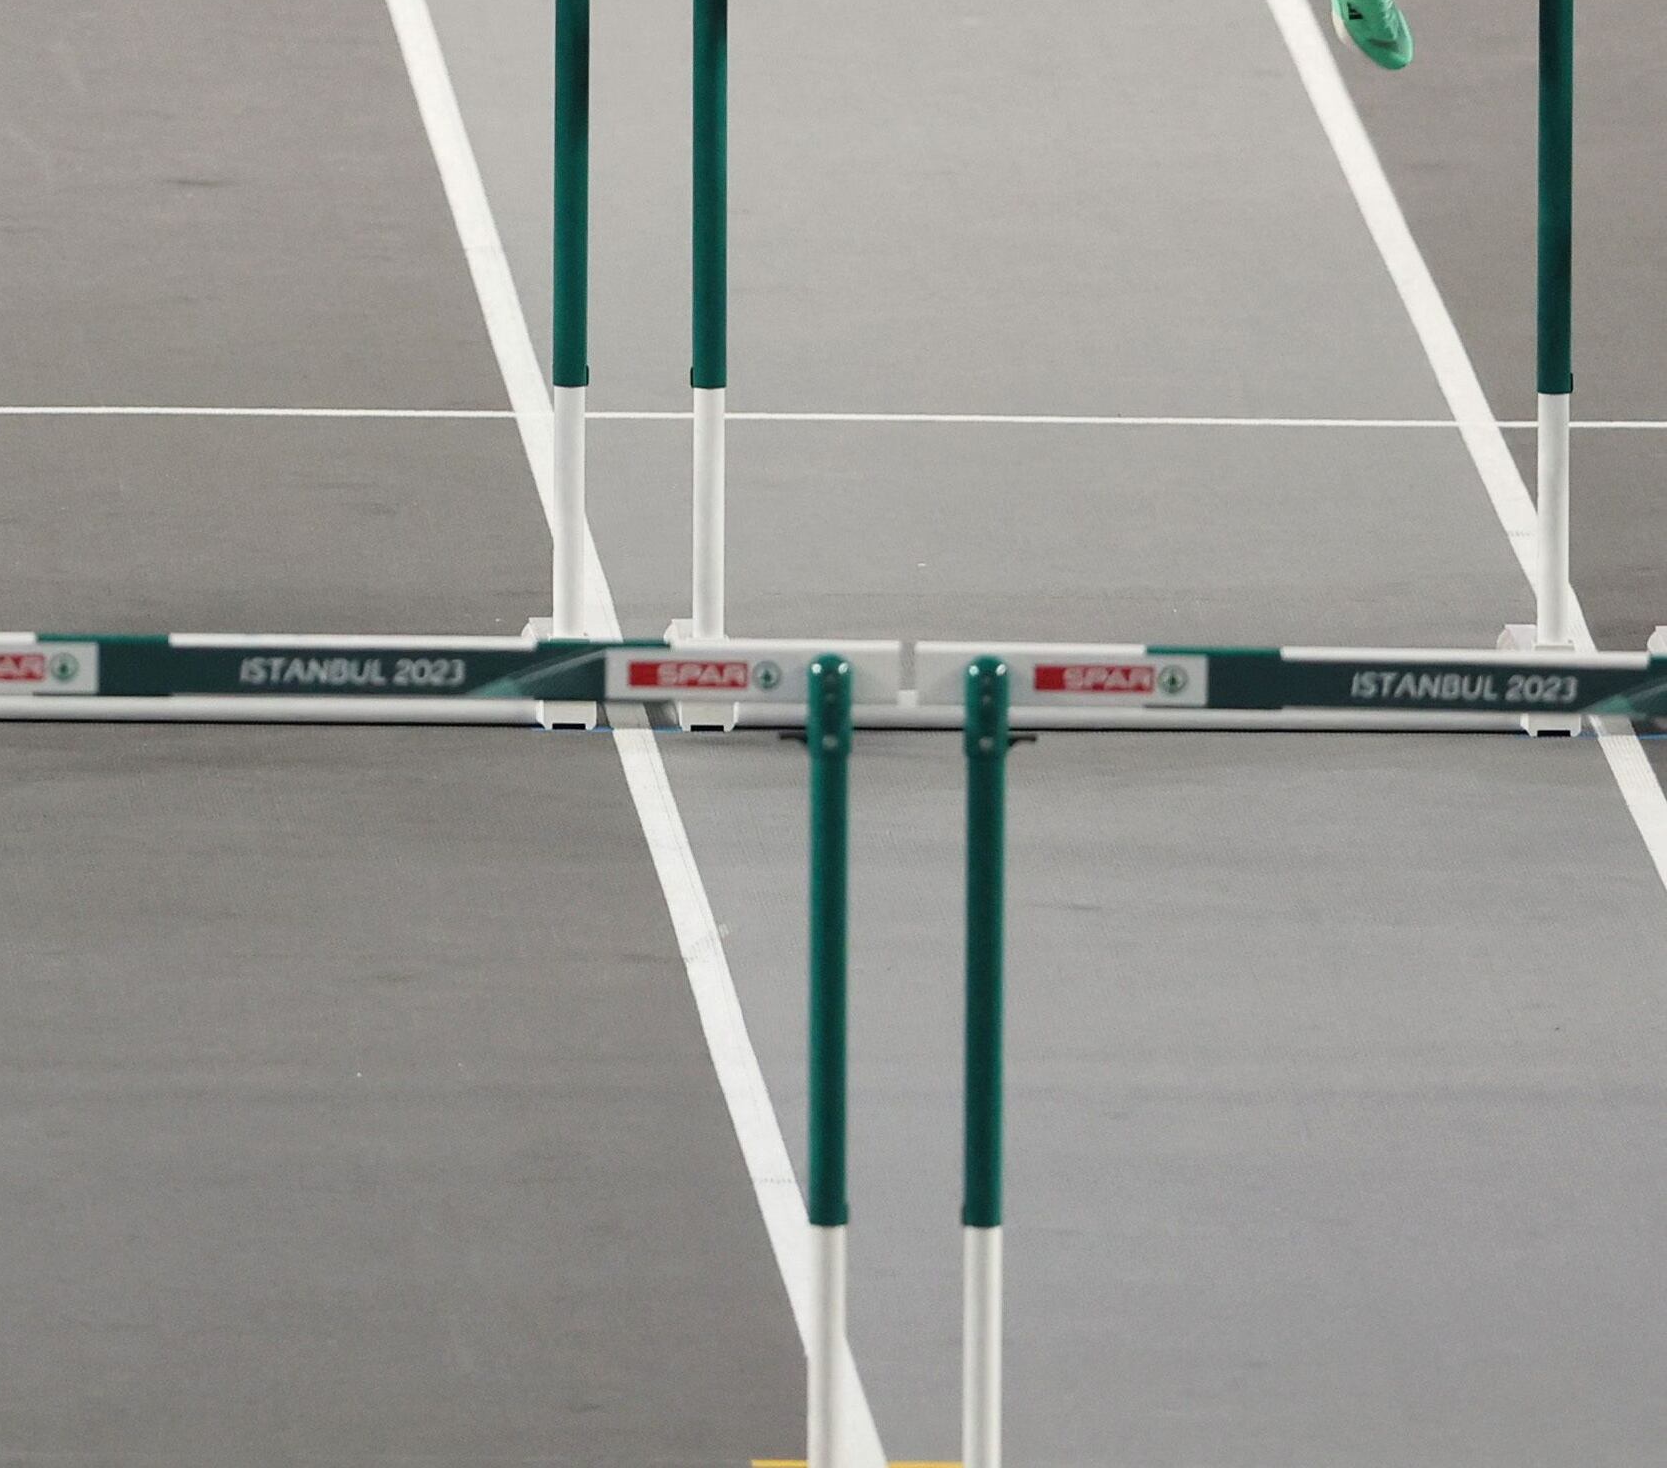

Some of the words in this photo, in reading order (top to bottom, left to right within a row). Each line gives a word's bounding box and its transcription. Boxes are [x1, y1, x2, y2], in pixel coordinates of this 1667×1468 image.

[239, 657, 386, 685] ISTANBUL
[394, 658, 464, 686] 2023
[657, 662, 747, 687] SPAR
[1063, 665, 1153, 691] SPAR
[1350, 670, 1499, 701] ISTANBUL
[1504, 674, 1578, 703] 2023
